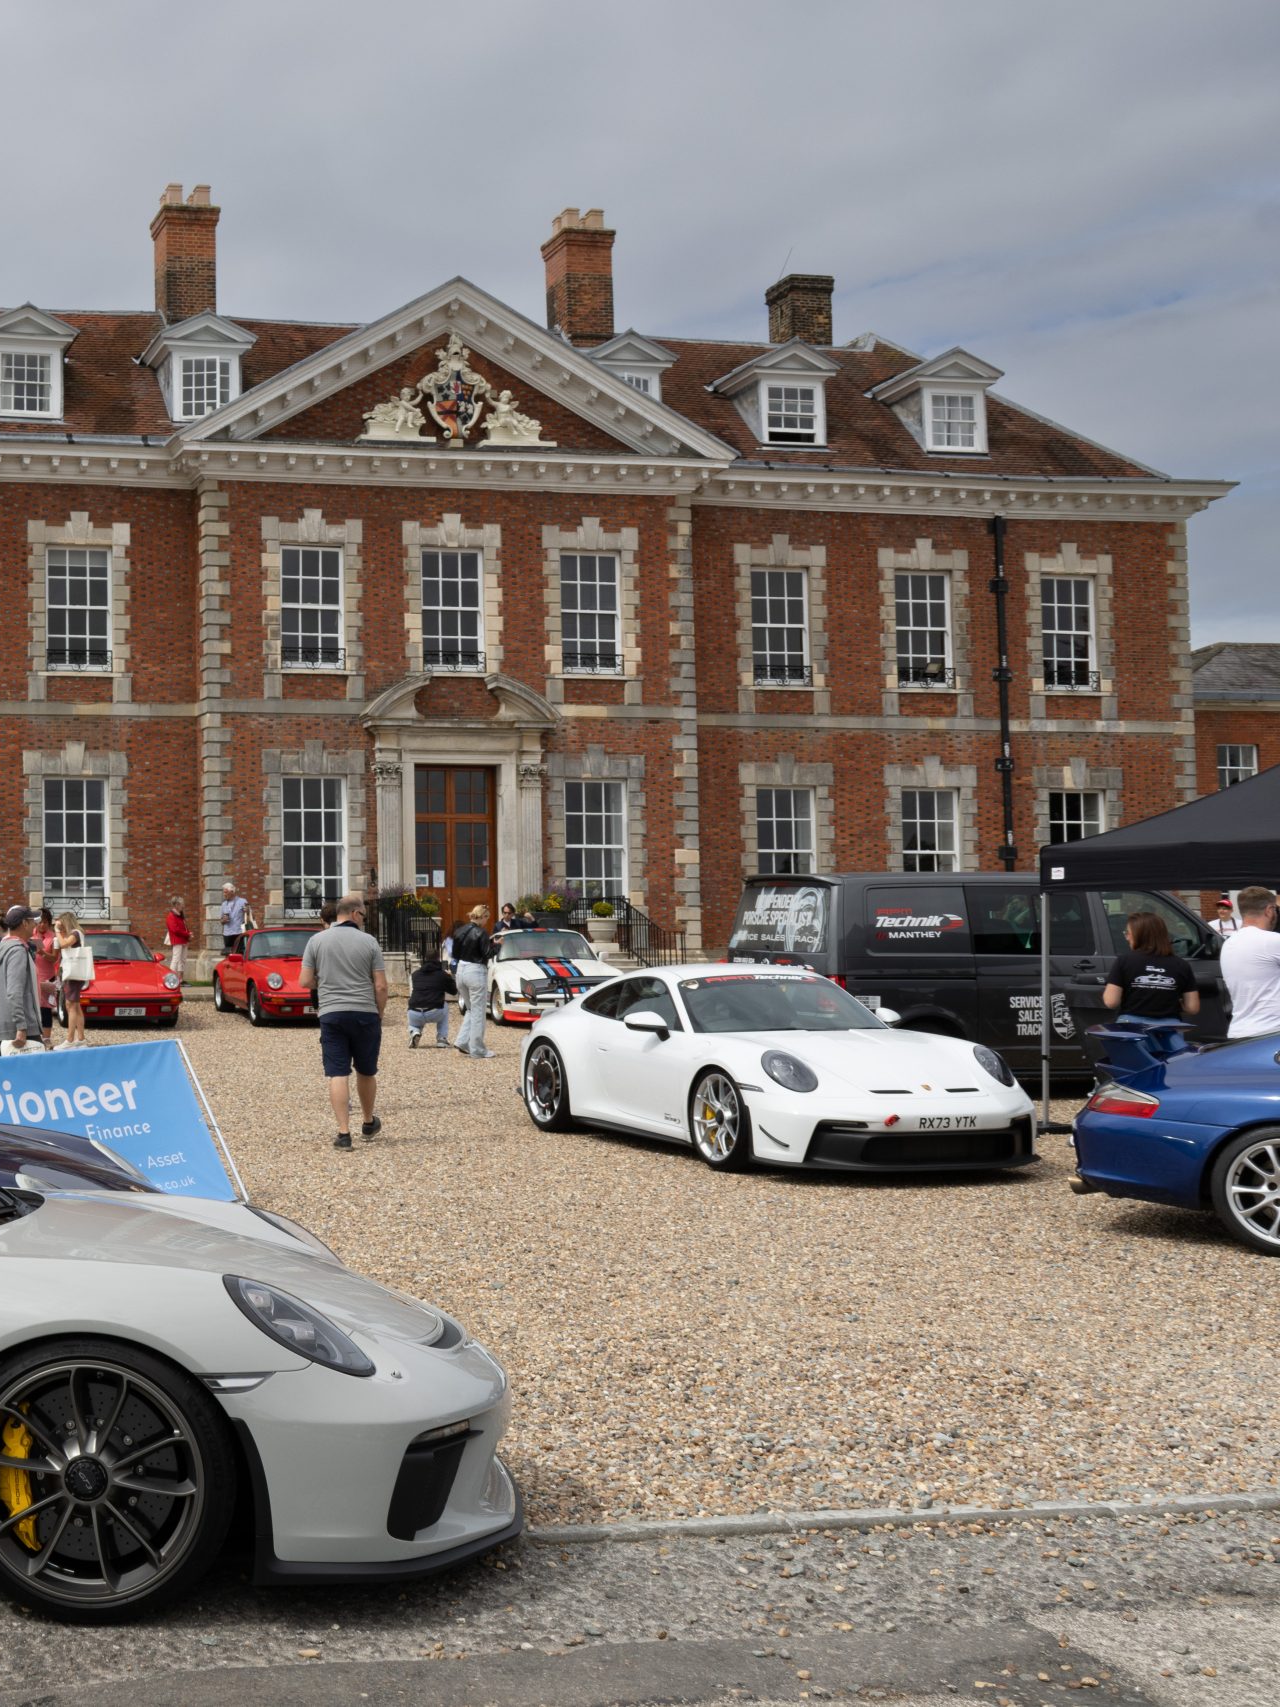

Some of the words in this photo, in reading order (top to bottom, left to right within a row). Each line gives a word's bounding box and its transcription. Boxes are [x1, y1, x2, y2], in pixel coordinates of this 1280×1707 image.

[876, 916, 944, 928] Technik
[761, 934, 785, 942] SALES
[888, 931, 942, 939] MANTHEY
[919, 1117, 951, 1129] RX73
[955, 1116, 977, 1128] YTK
[85, 1121, 152, 1142] Finance
[147, 1151, 186, 1169] Asset
